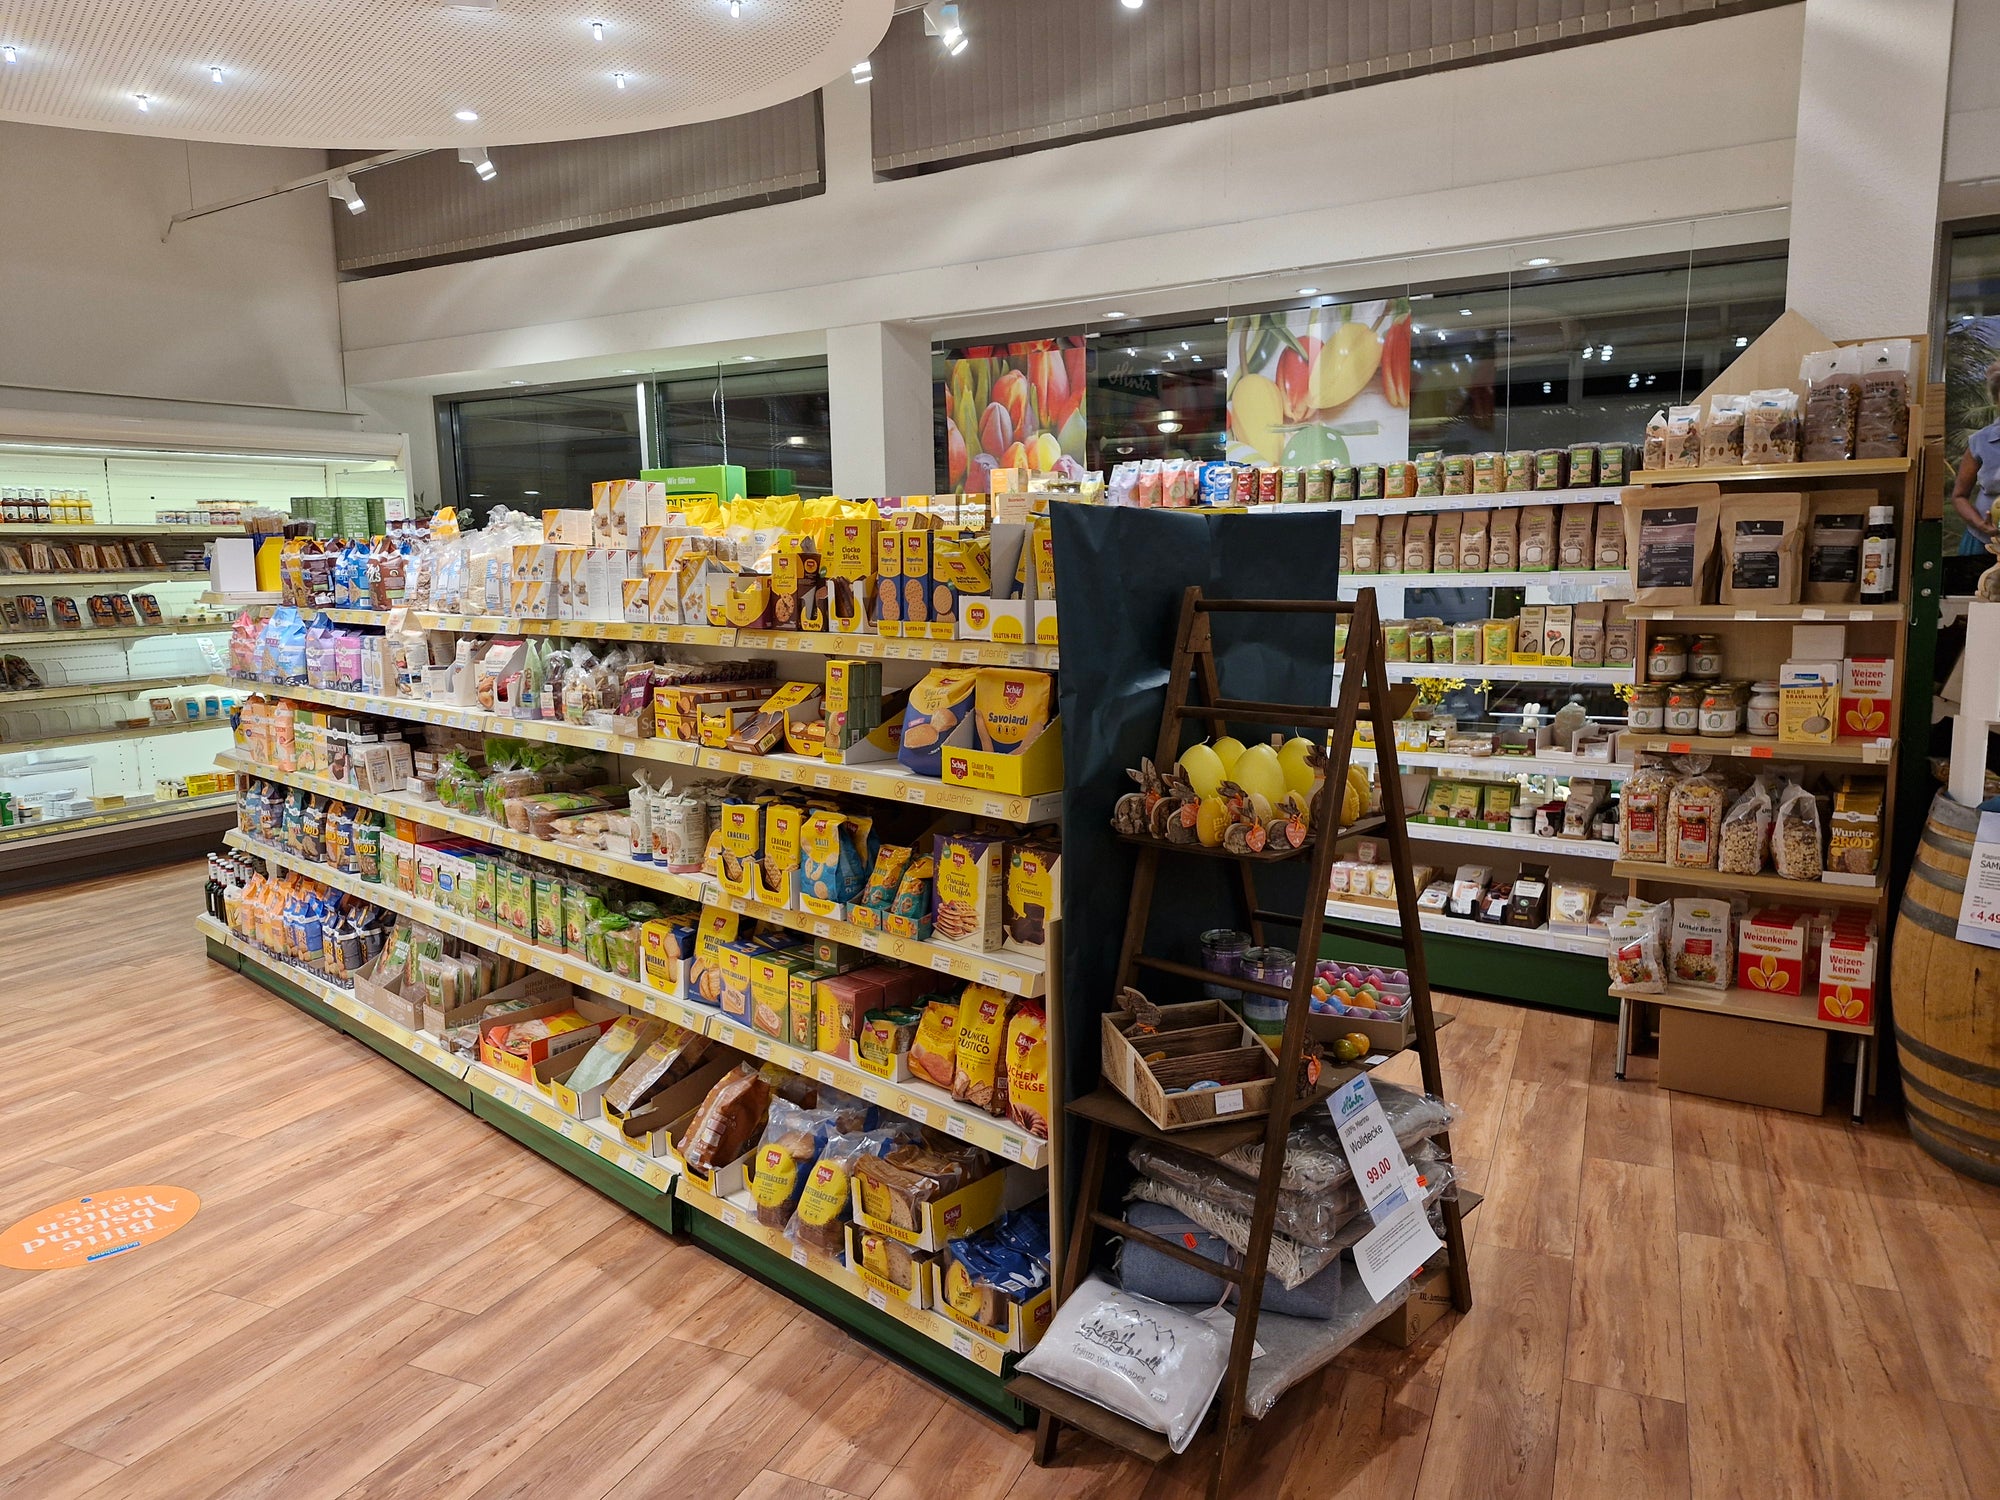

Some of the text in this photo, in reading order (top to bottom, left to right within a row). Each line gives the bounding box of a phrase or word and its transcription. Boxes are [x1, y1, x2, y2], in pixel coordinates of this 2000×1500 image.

[1851, 669, 1886, 678] Weizen-
[1854, 678, 1882, 687] keime
[1005, 685, 1023, 697] Schär
[988, 712, 1029, 725] Savoiardi
[951, 759, 967, 772] Schär
[936, 791, 974, 805] glutenfrei
[727, 831, 750, 841] CRACKERS
[1831, 827, 1875, 838] Wunder
[337, 836, 350, 846] ØD
[771, 837, 792, 848] CRACKERS
[1830, 836, 1874, 848] BRØD
[946, 874, 970, 888] Pancakes
[1016, 883, 1043, 897] Brownies
[832, 926, 862, 939] glutenfre
[1678, 922, 1699, 932] Unser
[1743, 932, 1798, 946] Weizenkeime
[424, 943, 438, 960] BIO
[949, 957, 972, 971] enfrei
[1829, 955, 1865, 966] Weizen-
[1832, 964, 1861, 975] keime
[983, 1003, 996, 1016] Schär
[960, 1027, 990, 1045] DUNKEL
[1017, 1036, 1034, 1050] Schär
[860, 1061, 888, 1076] GLUTEN-FREE
[1008, 1065, 1039, 1081] UCHEN
[1349, 1124, 1384, 1155] Wolldecke
[1366, 1157, 1391, 1184] 99,00
[36, 1195, 156, 1234] halten
[21, 1199, 178, 1254] Abstand
[872, 1221, 909, 1240] GLUTEN-FREE
[62, 1219, 156, 1252] Bitte
[864, 1272, 900, 1296] GLUTEN-FREE
[903, 1305, 940, 1332] glutenfrei
[955, 1313, 996, 1340] GLUTEN-FREE
